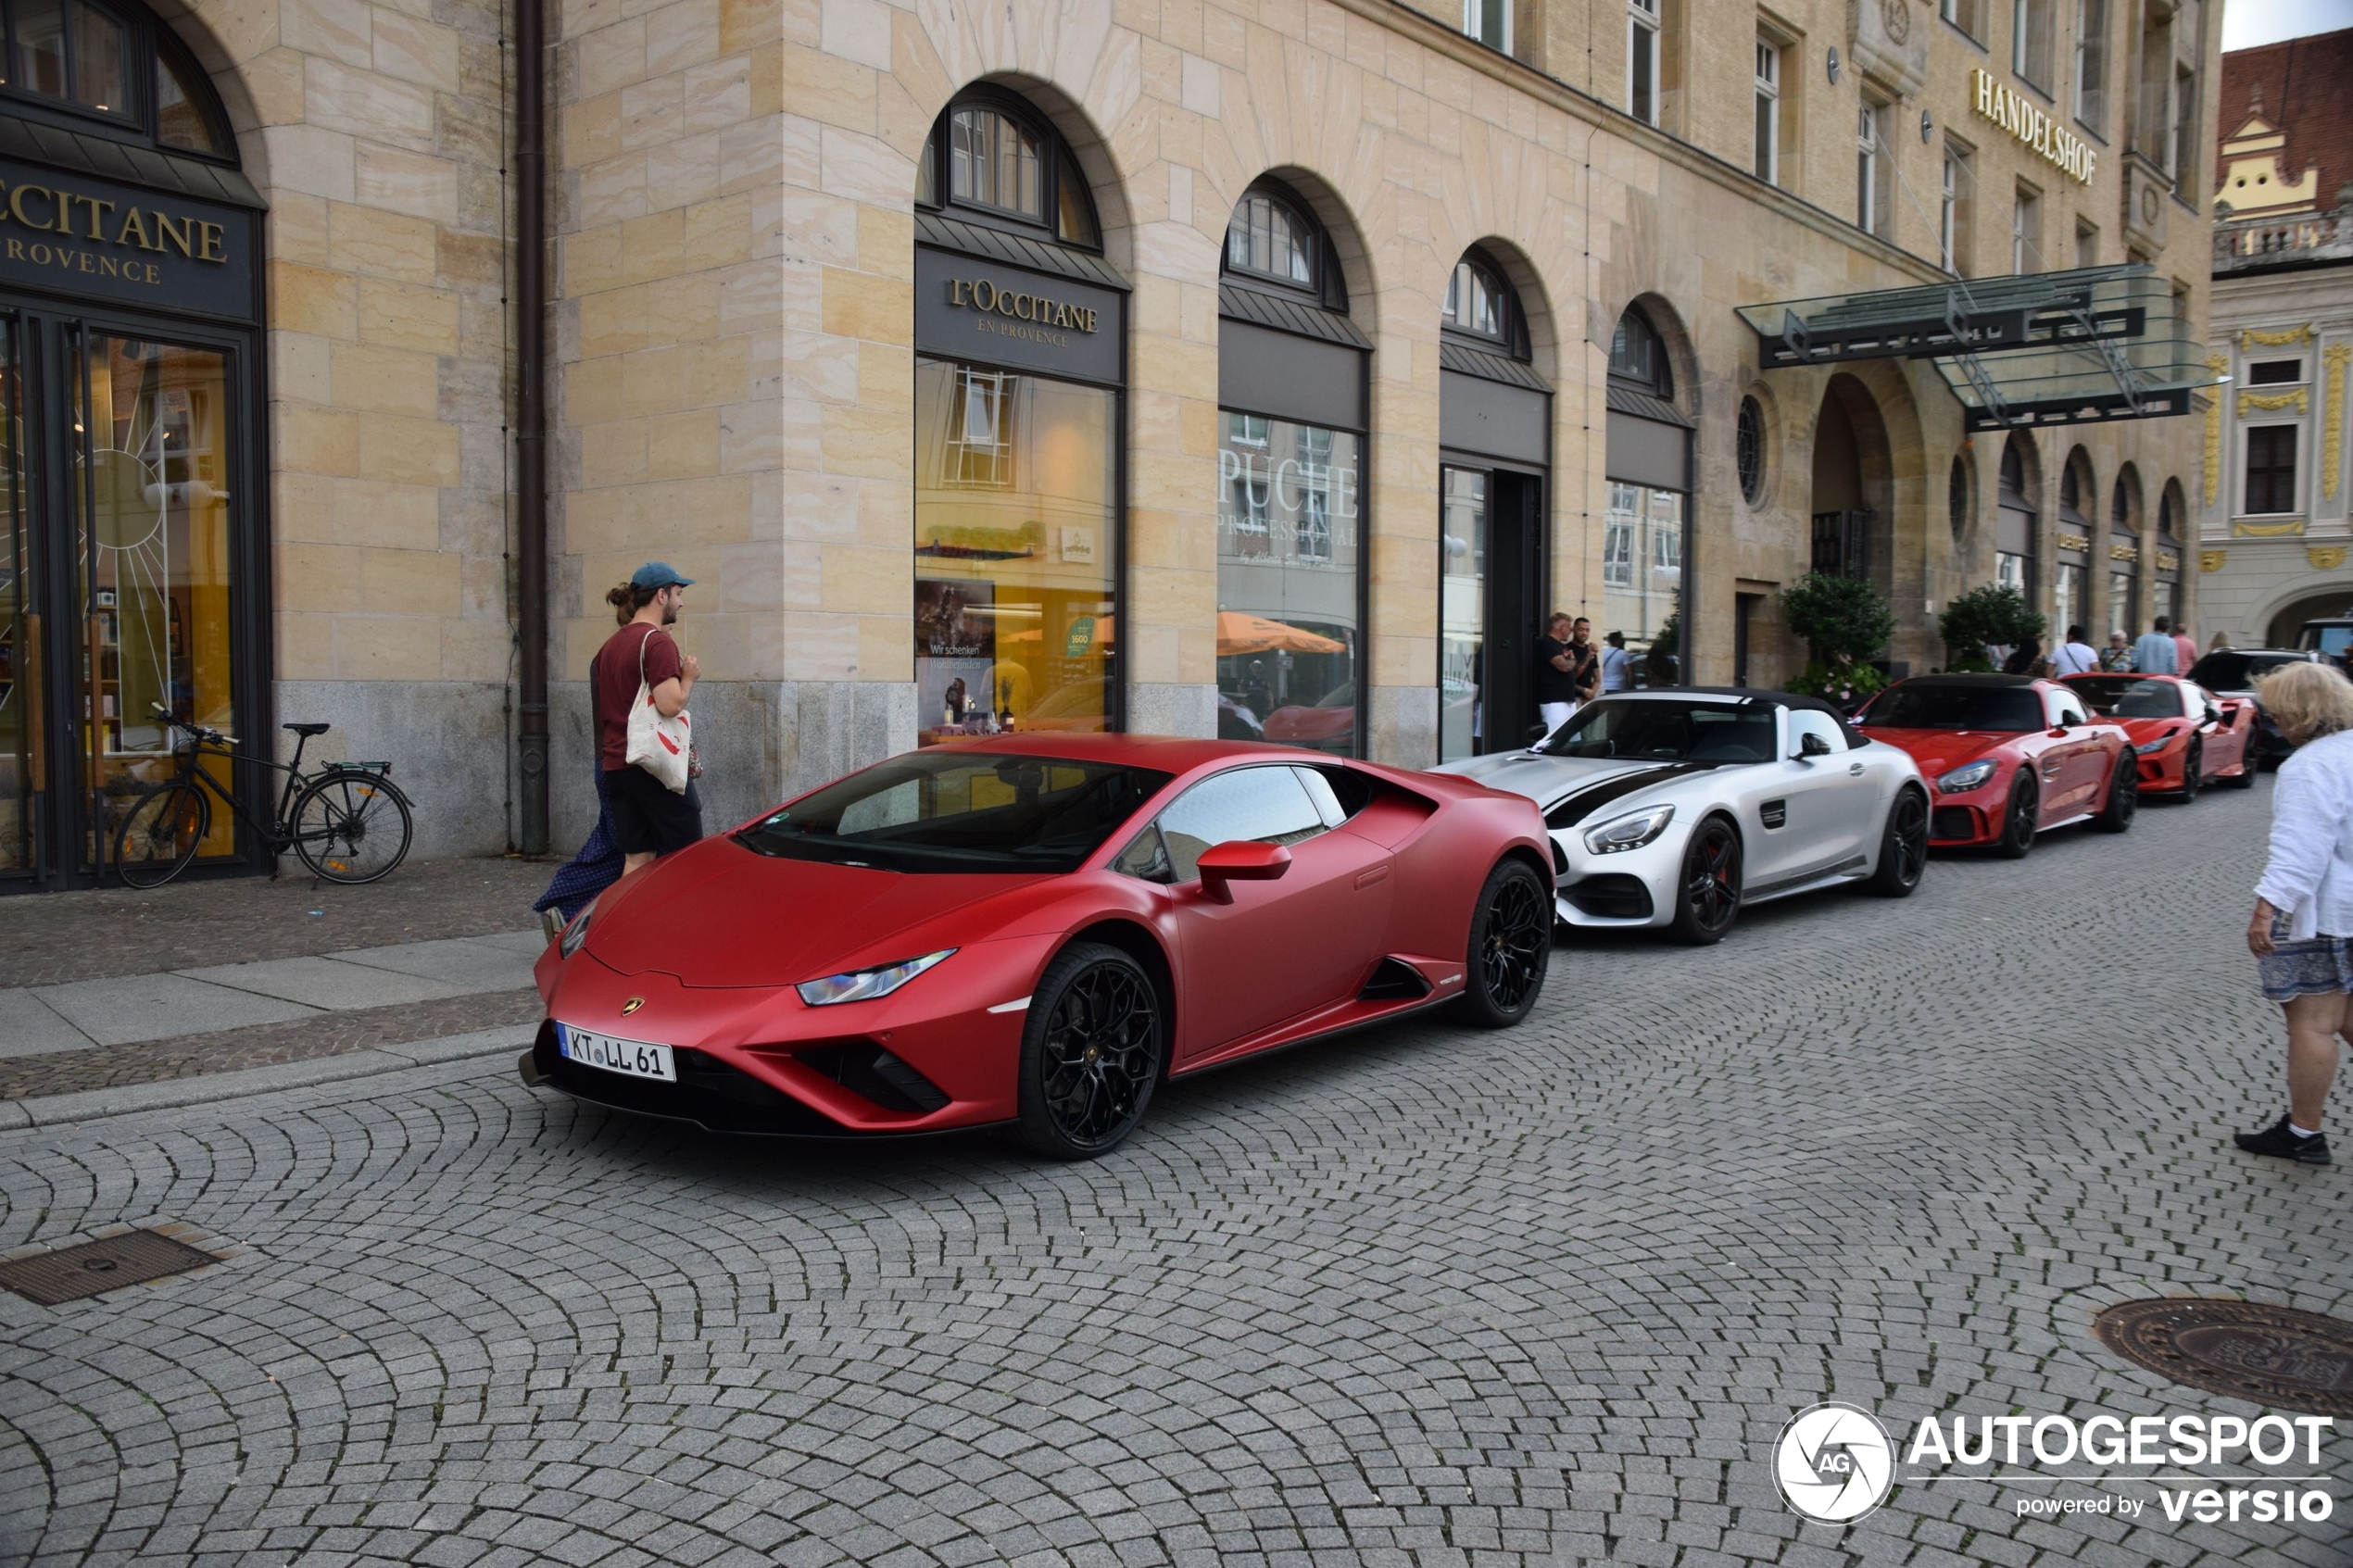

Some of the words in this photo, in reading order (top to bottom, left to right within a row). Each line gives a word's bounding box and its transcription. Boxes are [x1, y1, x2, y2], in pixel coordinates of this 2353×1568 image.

[1972, 68, 2097, 185] HANDELSHOF
[0, 179, 228, 263] CITANE
[0, 238, 160, 284] ROVENCE
[950, 278, 1099, 333] L'OCCITANE
[978, 319, 995, 333] EN
[1000, 322, 1068, 347] PROVENCE
[930, 644, 944, 655] Wir
[945, 645, 980, 656] schenken
[1071, 634, 1088, 644] 1600
[929, 659, 982, 671] Wohlbefinden
[571, 1031, 593, 1061] KT
[604, 1040, 633, 1071] LL
[636, 1047, 665, 1076] 61
